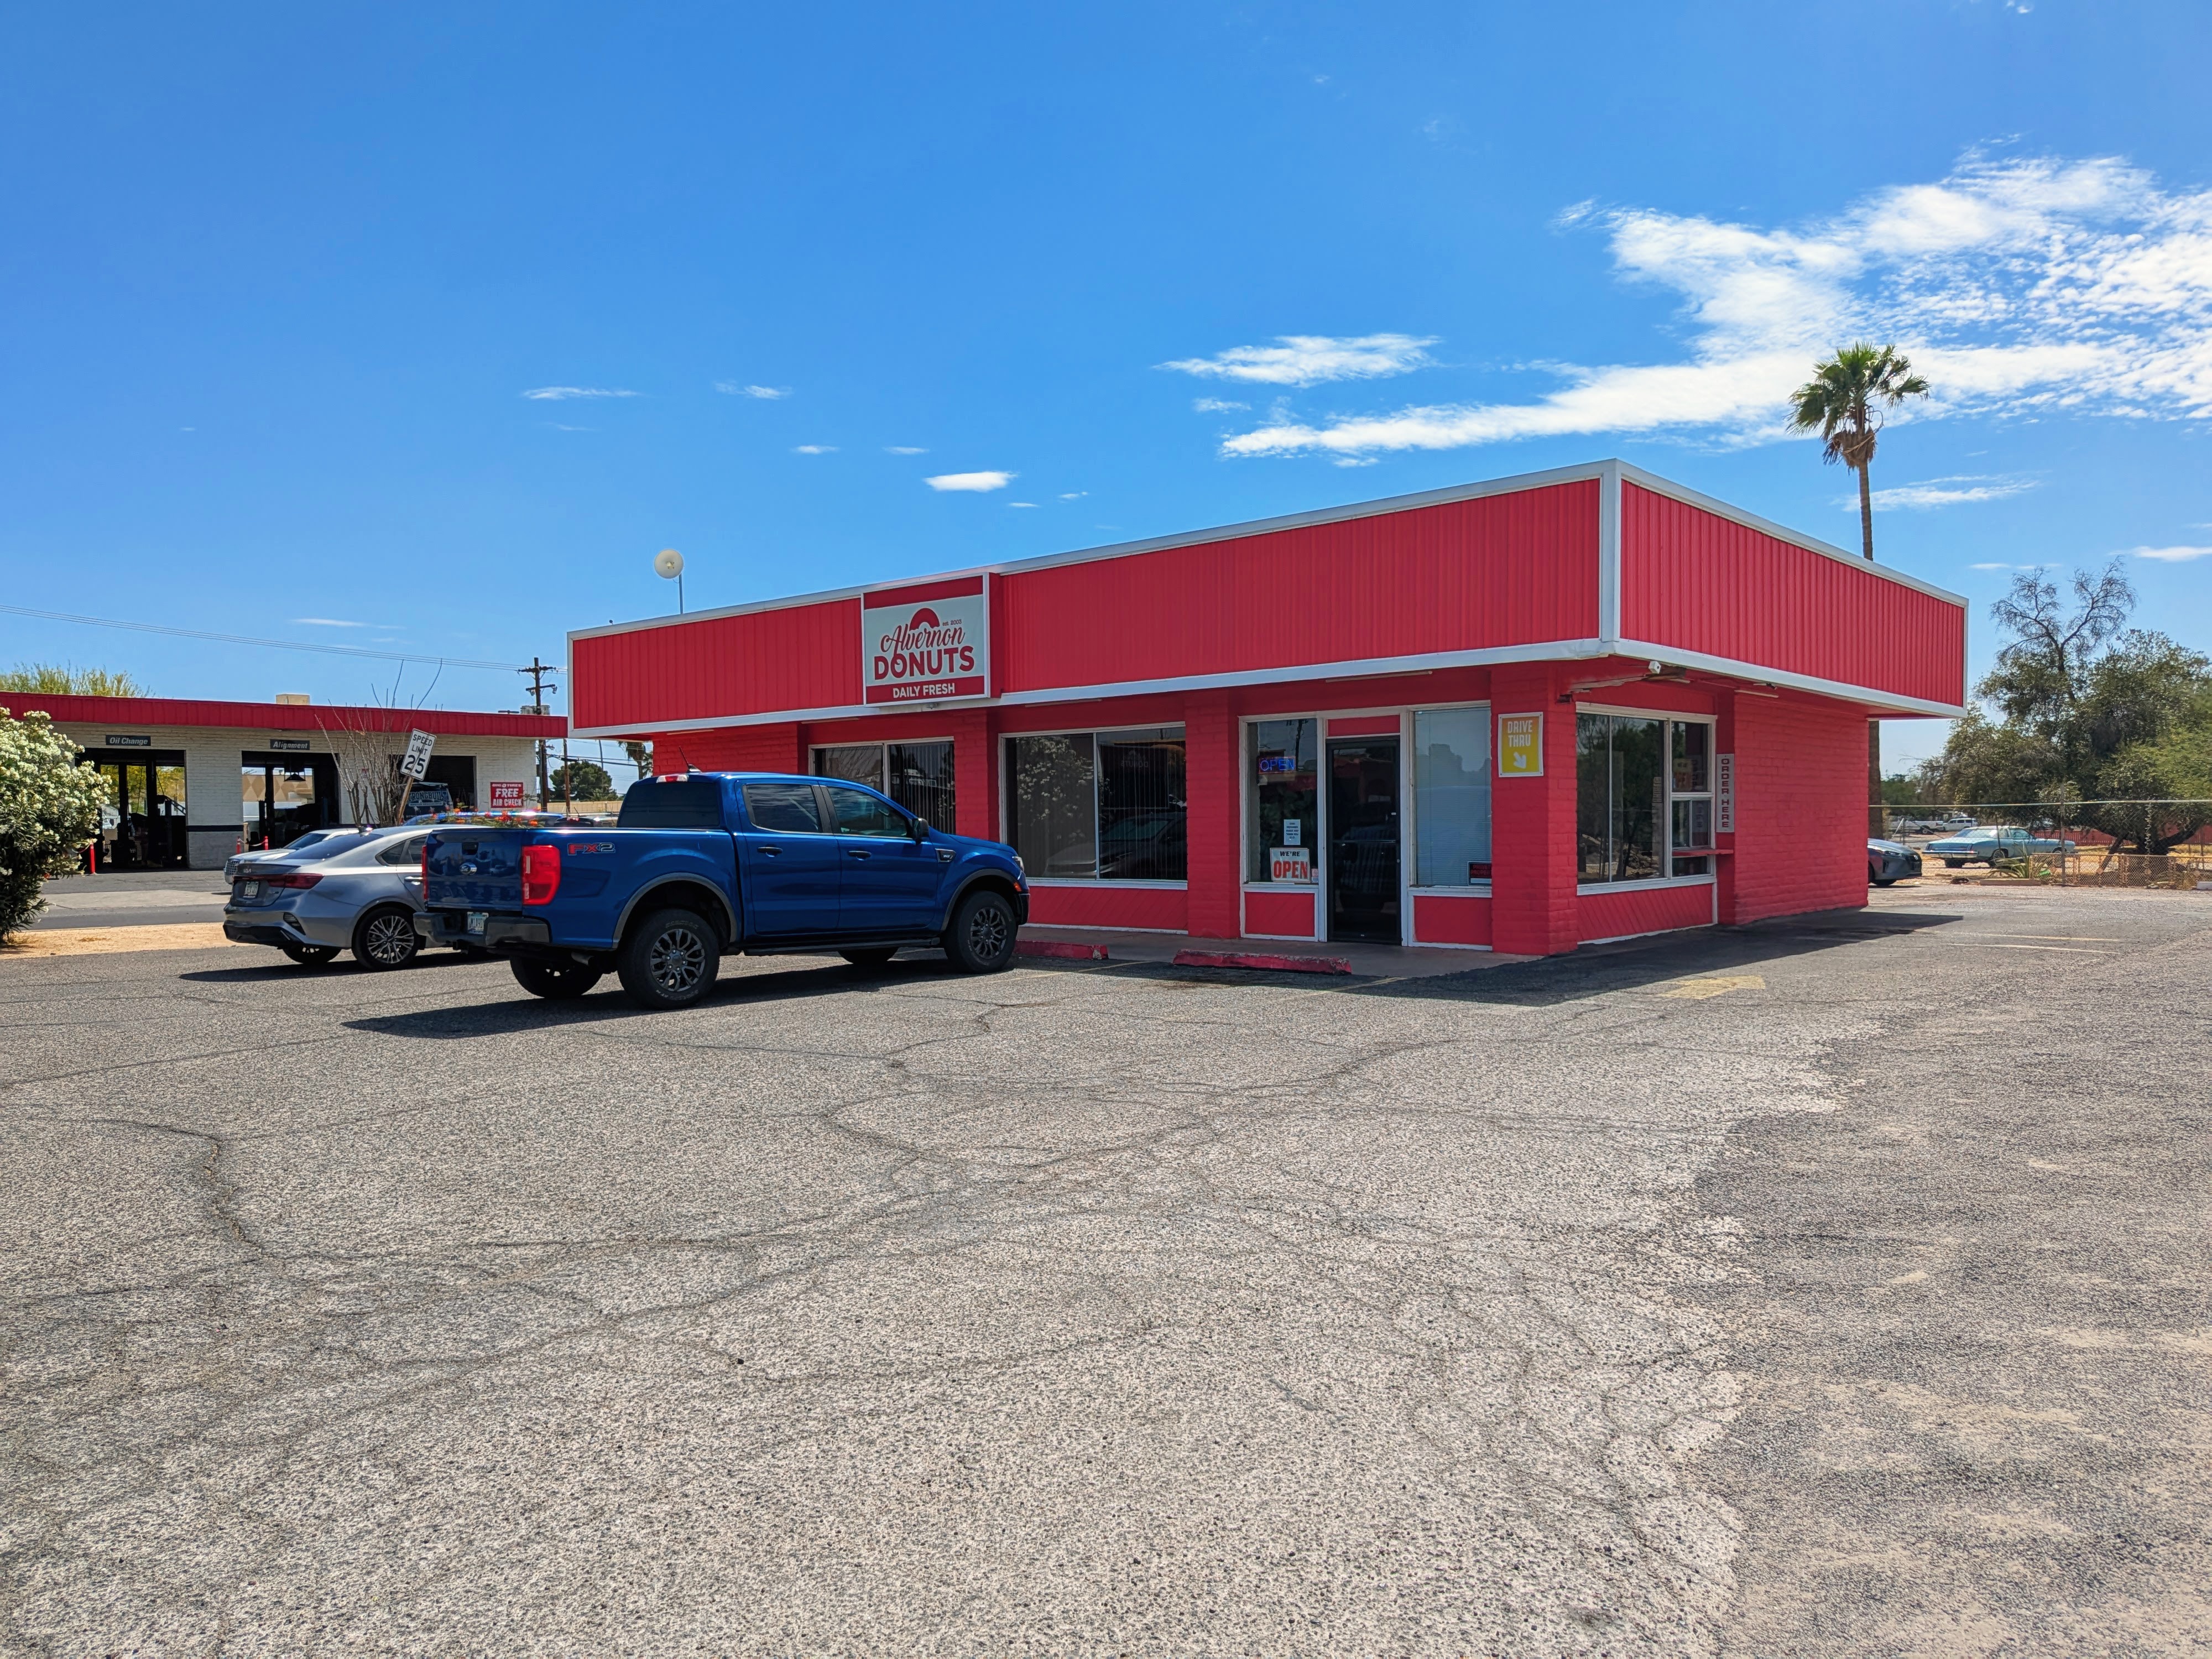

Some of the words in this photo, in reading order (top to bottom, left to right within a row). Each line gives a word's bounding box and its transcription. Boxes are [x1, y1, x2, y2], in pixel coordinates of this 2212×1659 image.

[880, 624, 966, 658] Alvernon
[874, 645, 975, 680] DONUTS
[893, 686, 921, 698] DAILY
[923, 682, 955, 696] FRESH
[1507, 720, 1533, 734] DRIVE
[121, 737, 148, 746] Change
[273, 741, 308, 749] Alignment
[413, 734, 433, 747] SPEED
[1508, 734, 1531, 747] THRU
[411, 744, 428, 756] LIMIT
[404, 754, 426, 774] 25
[1261, 759, 1295, 771] OPEN
[1721, 758, 1730, 795] ORDER
[495, 788, 519, 797] FREE
[1721, 799, 1730, 828] HERE
[568, 843, 615, 855] FX2
[1273, 860, 1308, 879] OPEN
